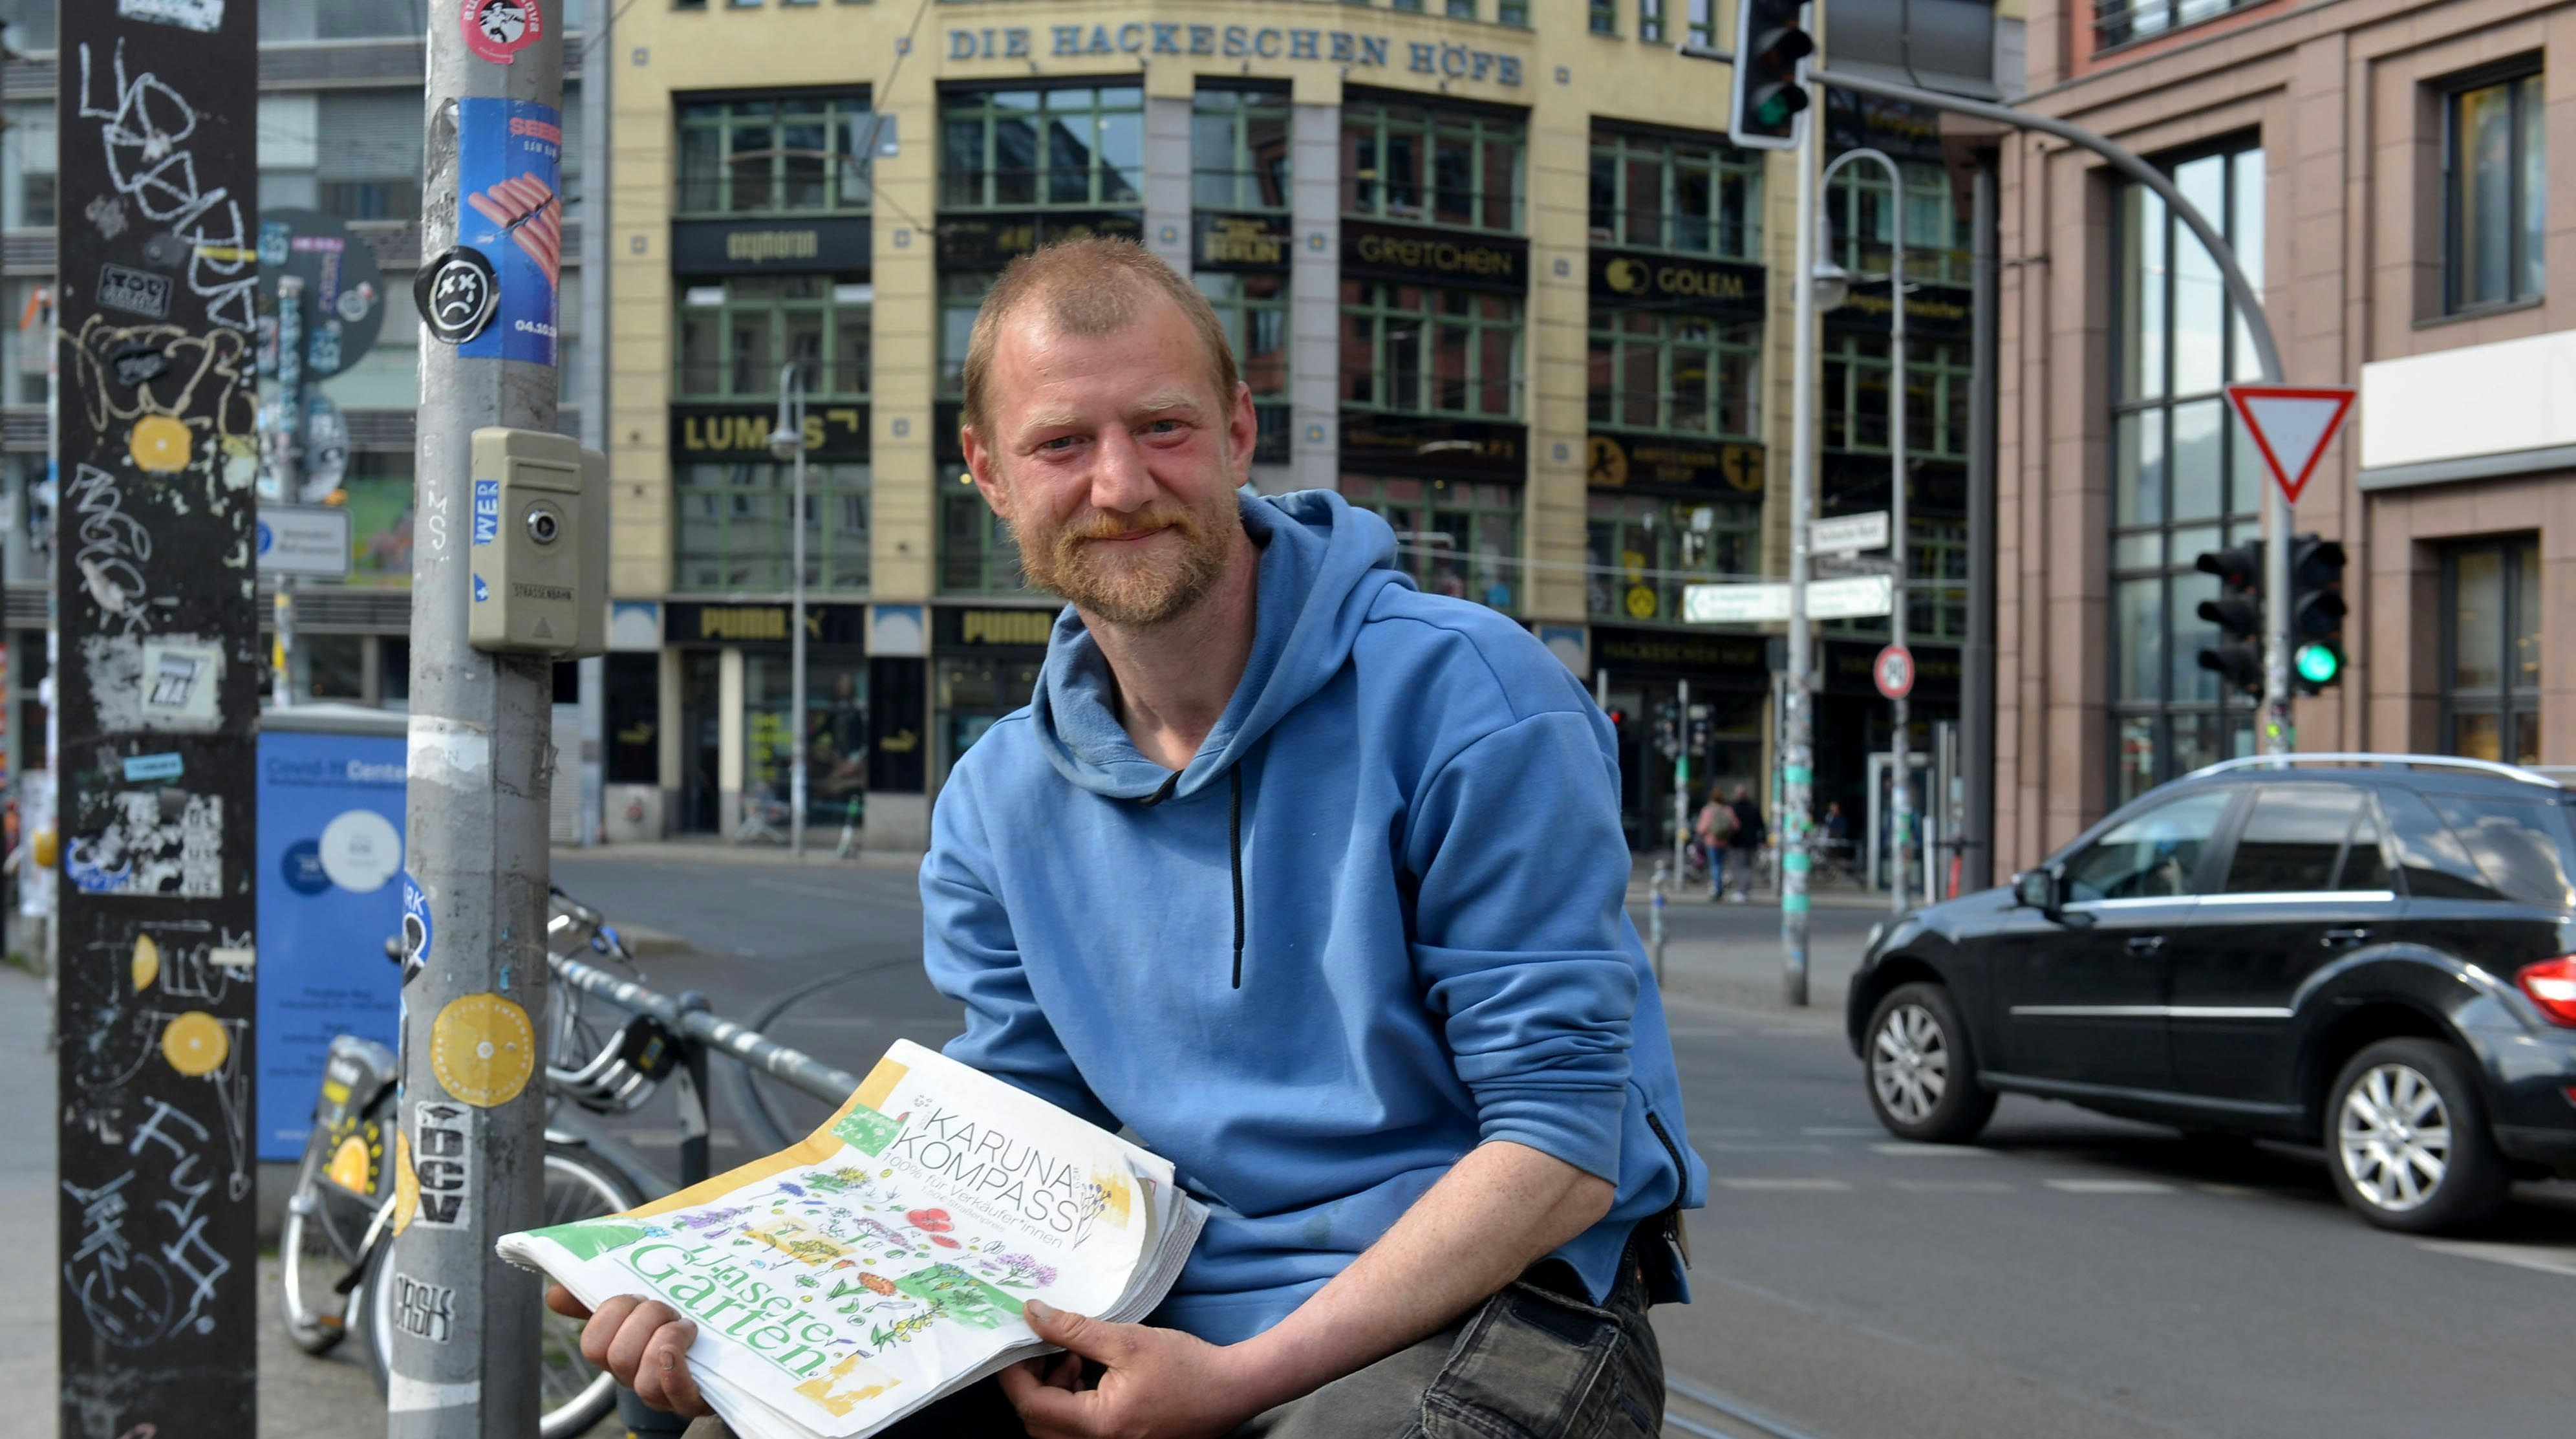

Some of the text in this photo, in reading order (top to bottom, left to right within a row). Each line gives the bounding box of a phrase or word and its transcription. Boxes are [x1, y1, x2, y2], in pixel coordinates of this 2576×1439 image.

[949, 22, 1523, 87] DIE HACKESCHEN HÖFE
[1357, 233, 1513, 275] GRETCHEN
[1657, 266, 1744, 299] GOLEM
[684, 415, 826, 450] LUMS
[513, 583, 572, 601] STRASSENBAHN
[701, 607, 786, 639] PUMA
[963, 611, 1052, 643] PUMA
[347, 759, 409, 783] Cente
[924, 1107, 1073, 1198] KARUNA
[883, 1152, 923, 1180] 100%
[925, 1173, 949, 1191] für
[892, 1127, 1079, 1233] KOMPASS
[683, 1244, 834, 1343] Unsere
